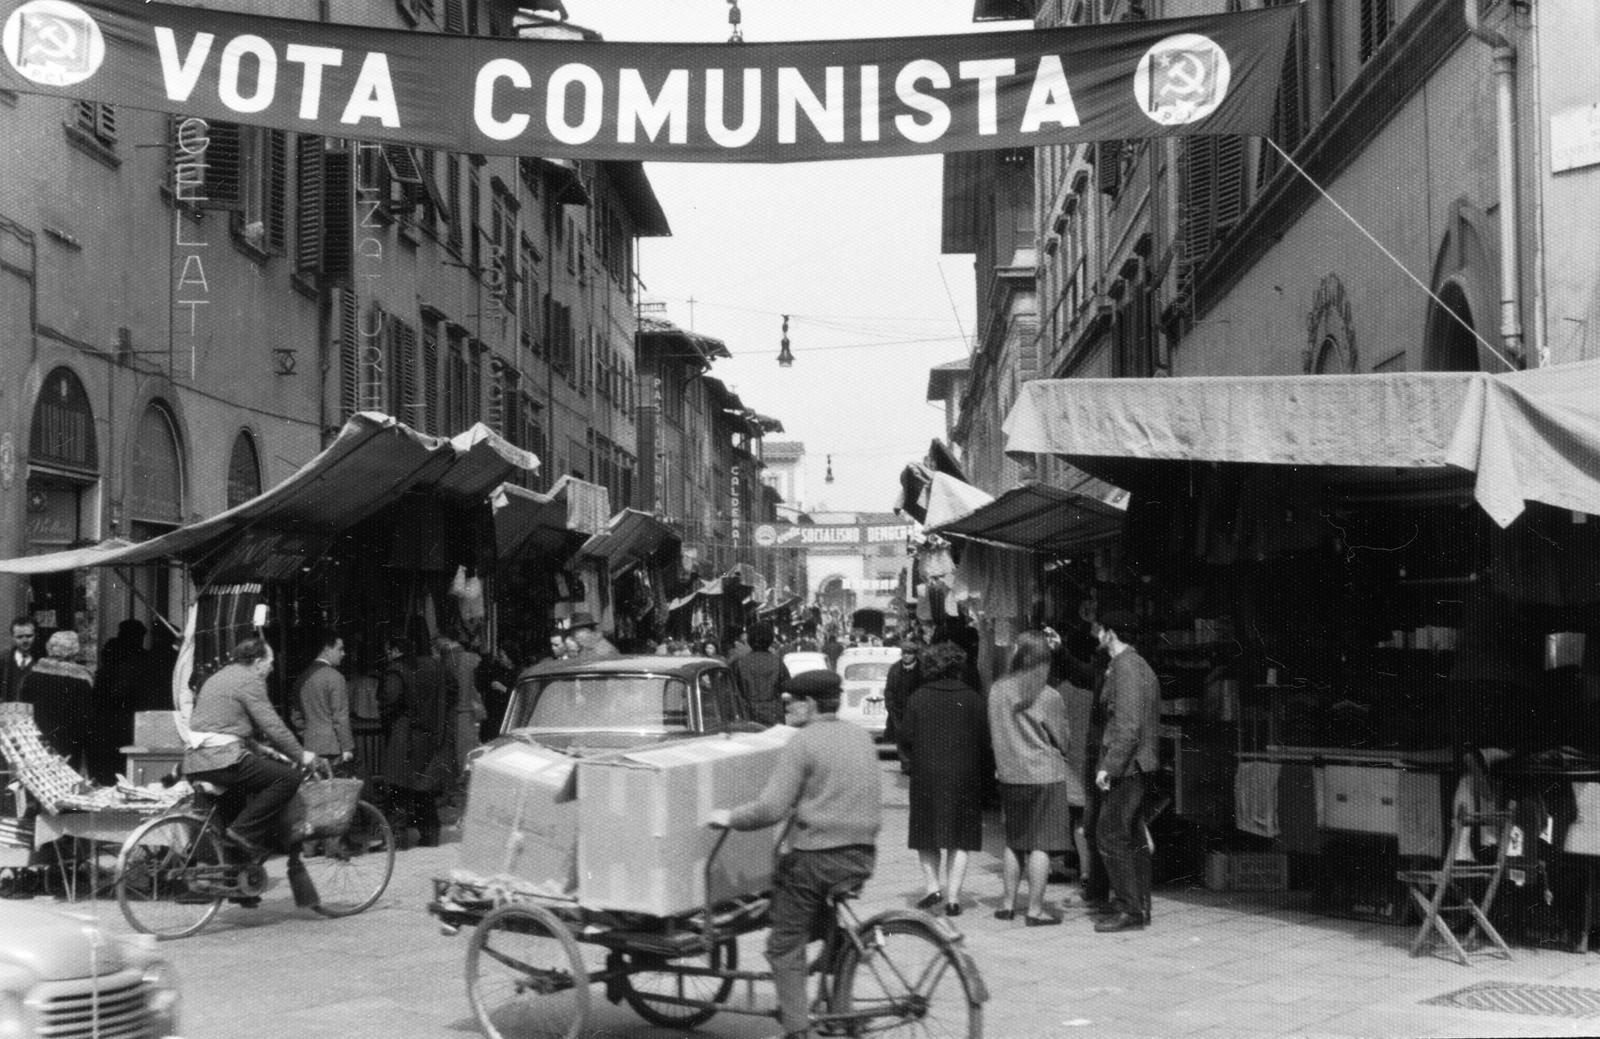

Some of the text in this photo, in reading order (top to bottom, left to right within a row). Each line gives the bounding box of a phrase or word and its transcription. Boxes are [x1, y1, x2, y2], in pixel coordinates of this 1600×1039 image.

[154, 26, 1080, 148] VOTA COMUNISTA
[176, 117, 211, 380] GELATI
[731, 466, 739, 549] CALDERAI
[801, 527, 859, 543] SOCIALISMO
